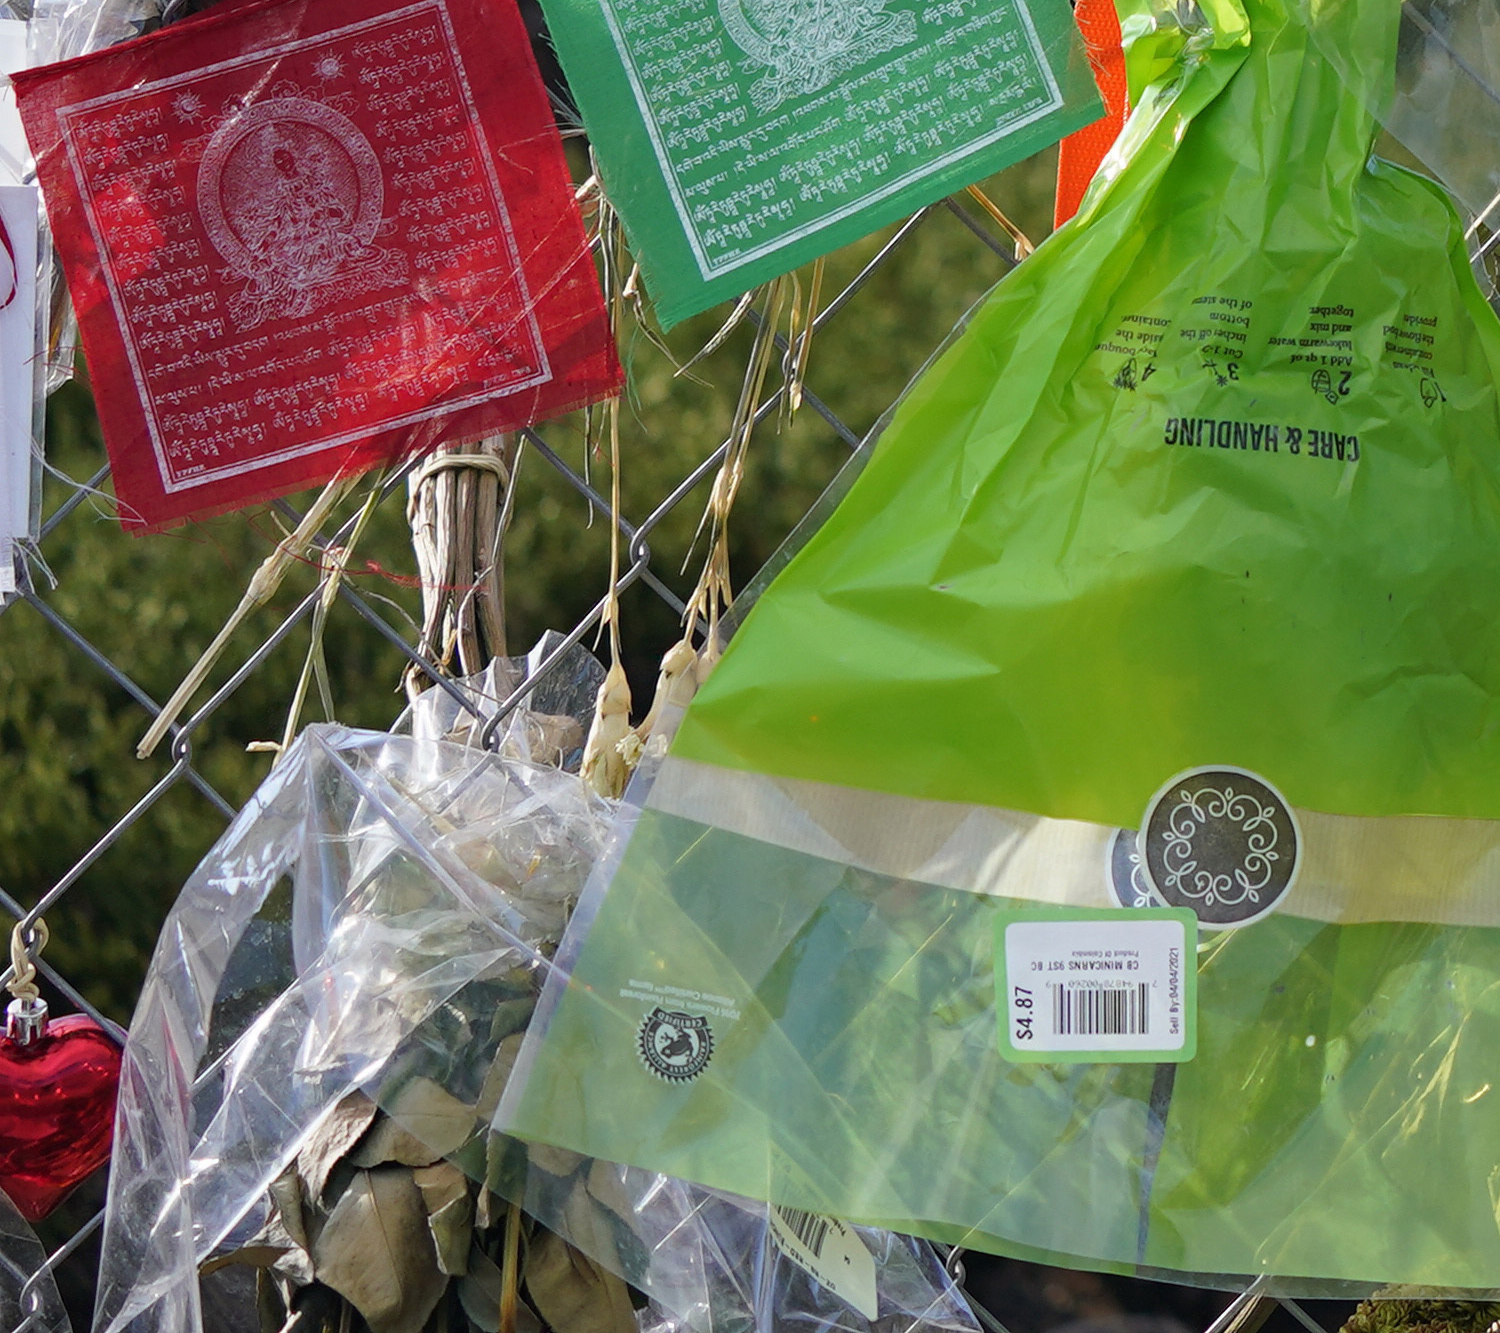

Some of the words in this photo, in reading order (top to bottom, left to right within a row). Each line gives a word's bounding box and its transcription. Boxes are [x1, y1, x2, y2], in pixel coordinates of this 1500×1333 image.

[1219, 296, 1237, 310] the
[1239, 299, 1252, 312] of
[1309, 321, 1329, 334] mix
[1332, 322, 1352, 335] and
[1115, 328, 1133, 341] the
[1267, 335, 1295, 348] water
[1298, 336, 1352, 352] lukewarm
[1330, 353, 1352, 366] Add
[1141, 362, 1156, 382] 4
[1226, 362, 1239, 381] 3
[1338, 370, 1352, 396] 2
[1165, 417, 1279, 454] HANDLING
[1286, 428, 1304, 455] &
[1308, 428, 1360, 463] CARE
[1047, 961, 1065, 971] 9ST
[1069, 961, 1123, 971] MINICARNS
[1127, 961, 1139, 971] CB
